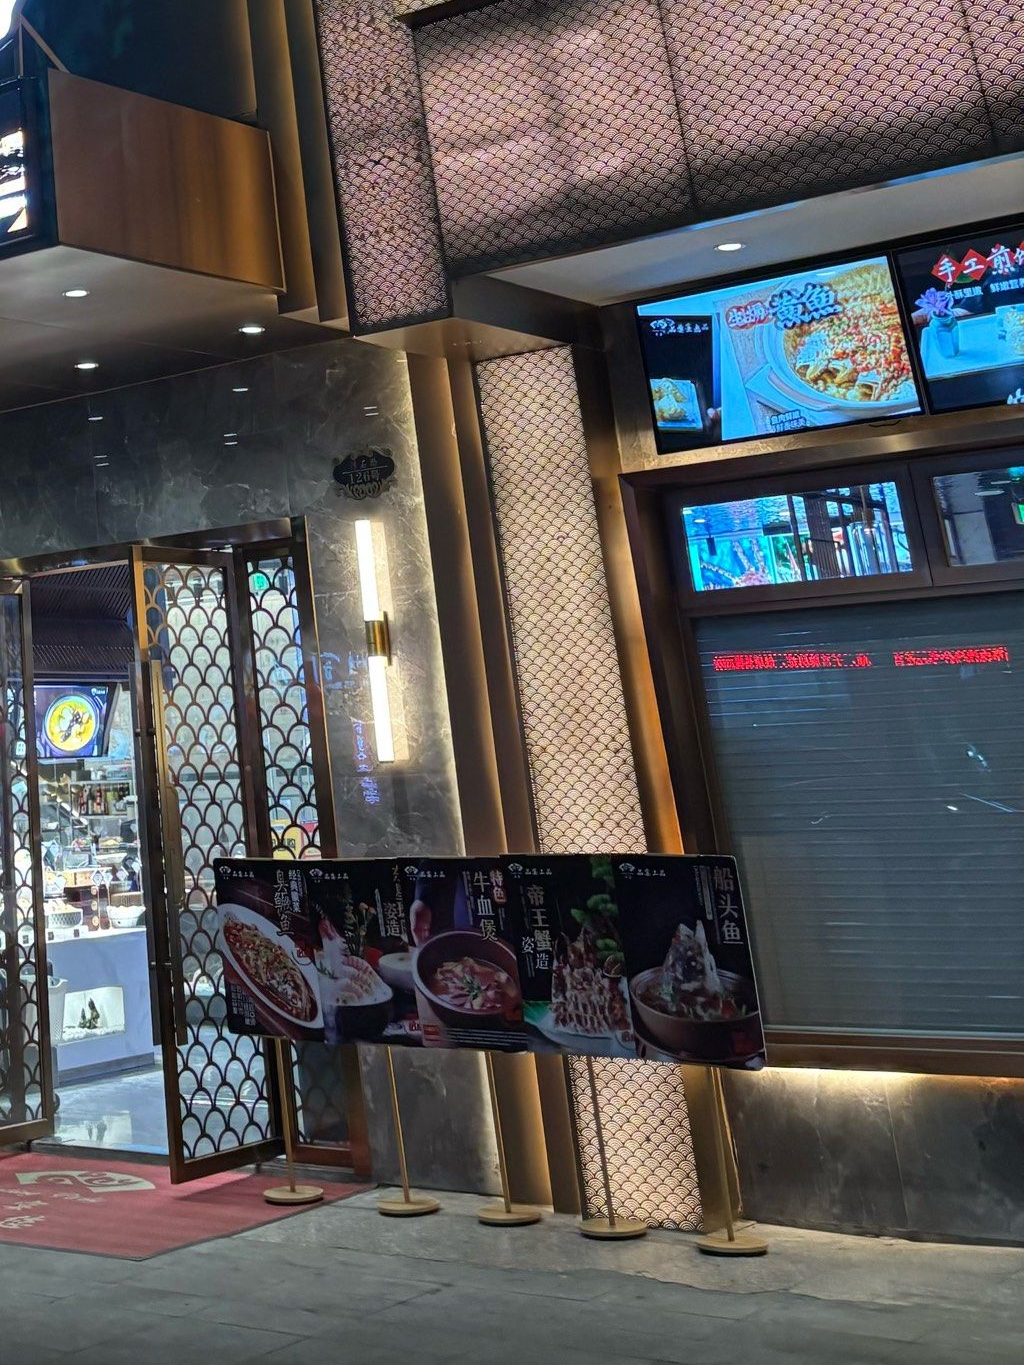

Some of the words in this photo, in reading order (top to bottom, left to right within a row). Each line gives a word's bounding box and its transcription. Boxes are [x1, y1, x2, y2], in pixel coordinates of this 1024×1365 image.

[473, 870, 498, 942] 牛血煲
[526, 884, 553, 951] 帝王蟹
[713, 866, 744, 944] 船头鱼
